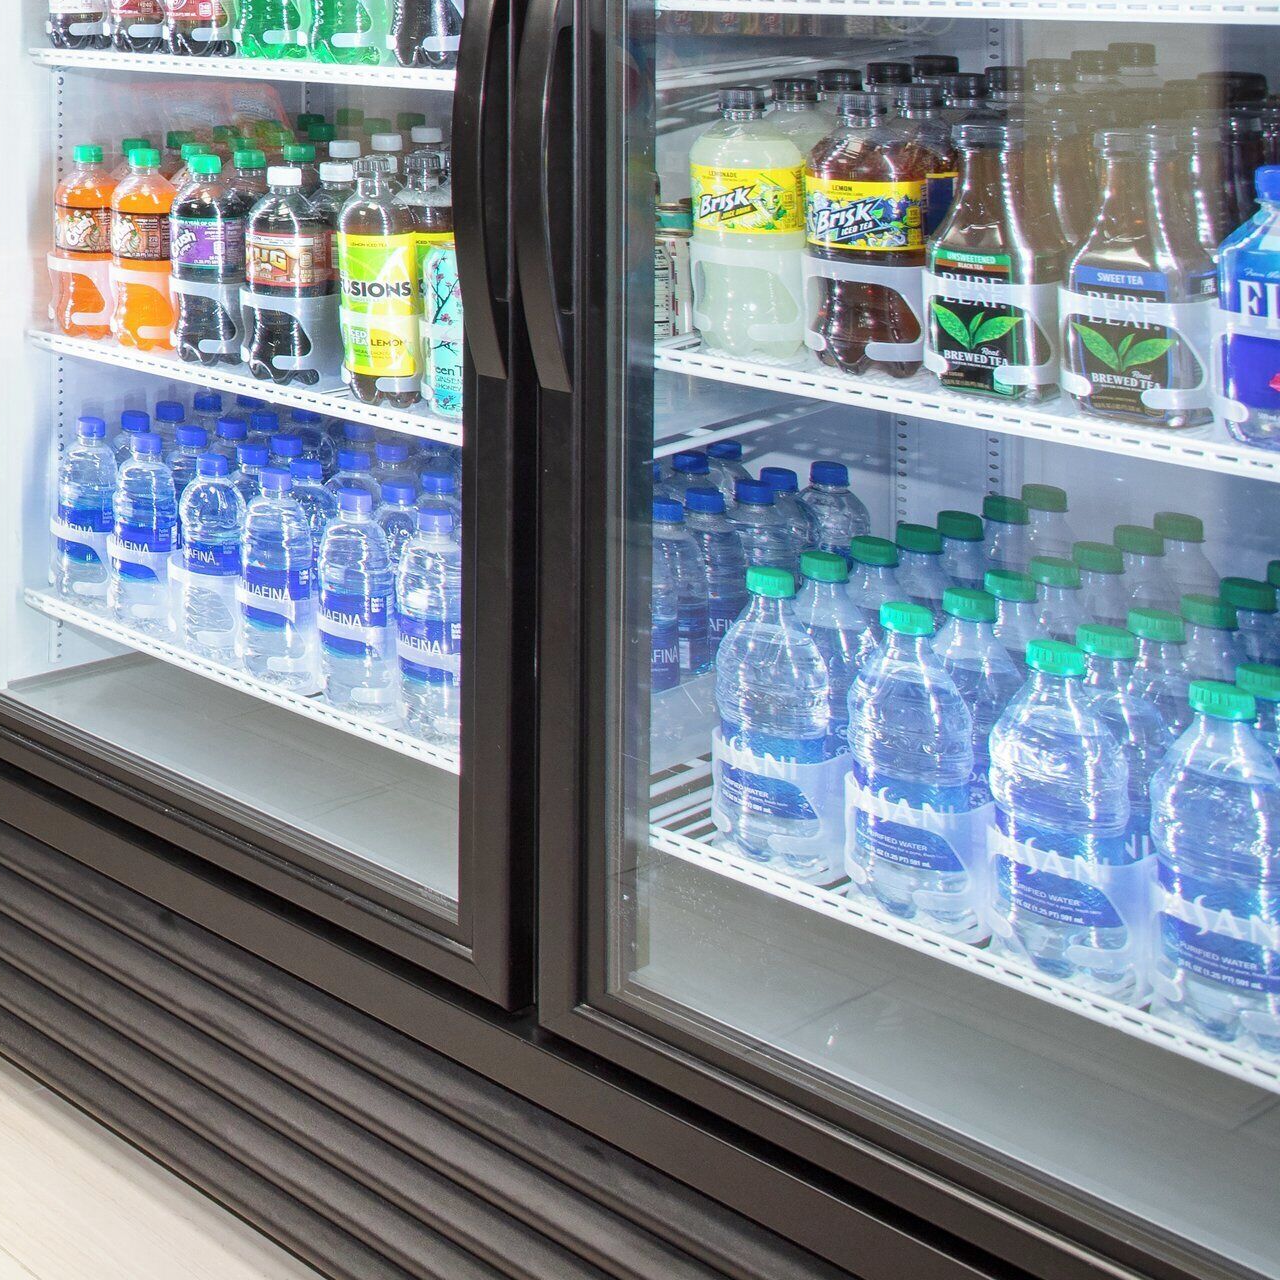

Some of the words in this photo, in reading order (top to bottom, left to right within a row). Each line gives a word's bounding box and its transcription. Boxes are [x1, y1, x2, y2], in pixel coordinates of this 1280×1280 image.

[700, 185, 756, 215] Brisk
[817, 200, 874, 231] Brisk
[841, 225, 859, 236] ICED
[859, 221, 873, 232] TEA
[946, 252, 996, 264] UNSWEETENED
[1096, 272, 1123, 283] SWEET
[1125, 275, 1144, 285] TEA
[943, 349, 988, 363] BREWED
[989, 356, 1008, 368] TEA
[899, 840, 928, 852] WATER
